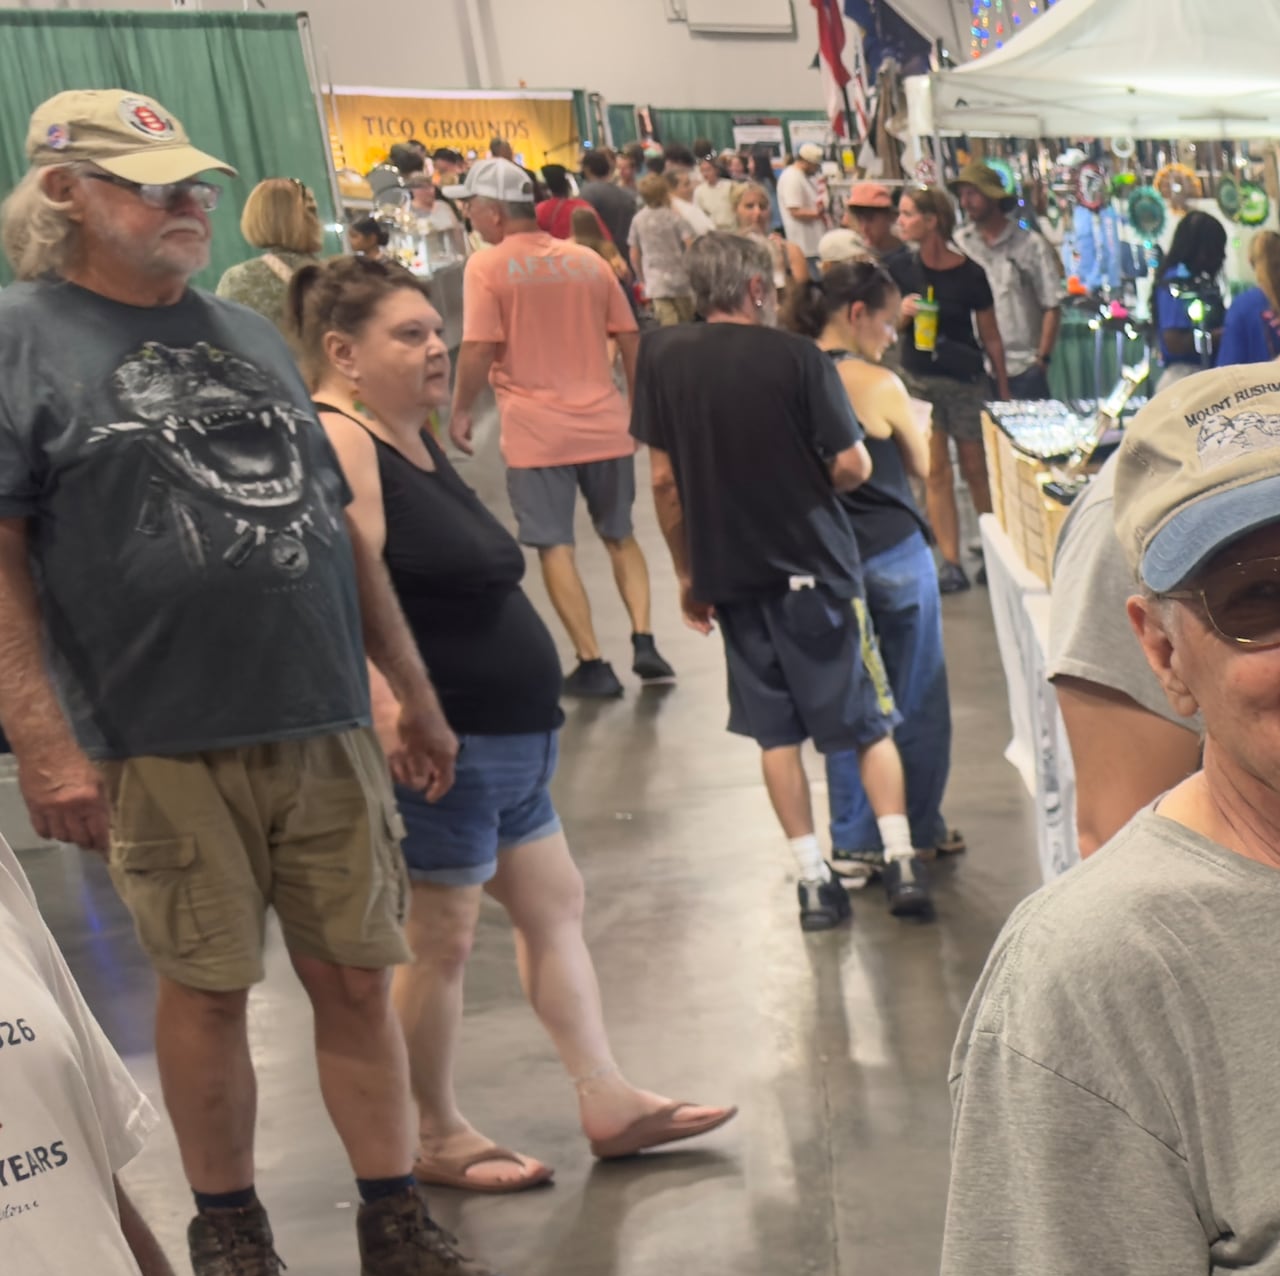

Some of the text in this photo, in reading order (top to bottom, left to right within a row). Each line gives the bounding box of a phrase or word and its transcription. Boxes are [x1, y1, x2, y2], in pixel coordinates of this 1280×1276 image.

[362, 116, 529, 139] TICO GROUNDS
[1184, 397, 1232, 428] MOUNT
[0, 1018, 35, 1048] 26
